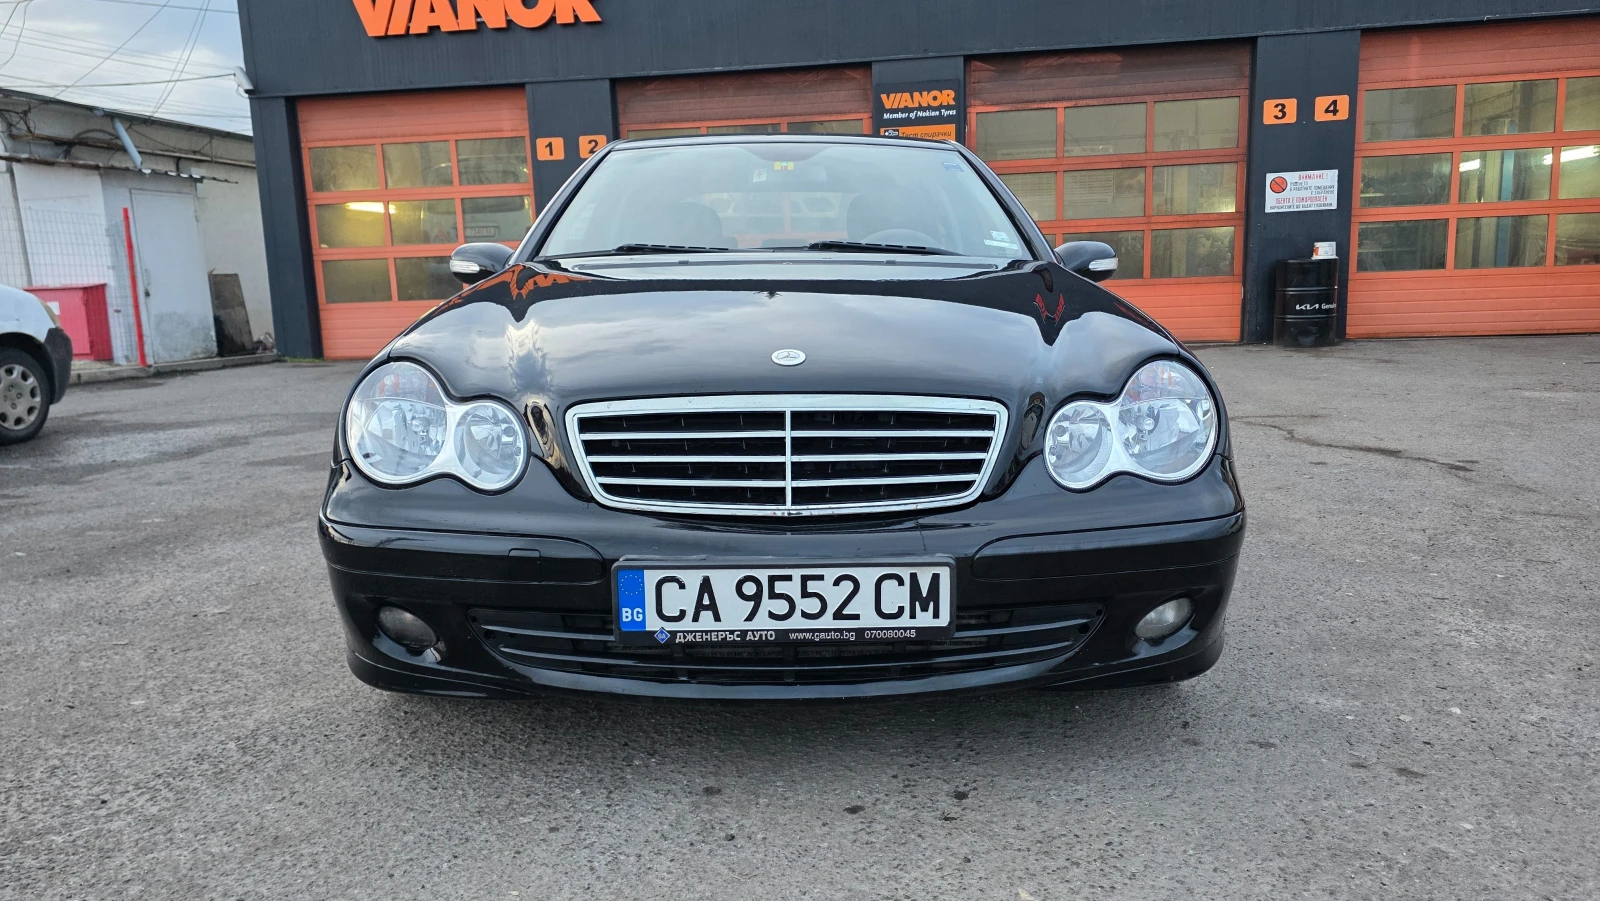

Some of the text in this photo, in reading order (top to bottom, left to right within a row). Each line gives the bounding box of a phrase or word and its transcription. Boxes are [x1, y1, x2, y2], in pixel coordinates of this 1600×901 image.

[880, 90, 956, 109] VIANOR
[1324, 99, 1339, 116] 4
[909, 111, 917, 119] of
[941, 109, 957, 117] Tyres
[1273, 103, 1287, 120] 3
[545, 142, 554, 157] 1
[587, 139, 599, 155] 2
[655, 572, 940, 622] CA 9552 CM
[621, 608, 643, 622] BG
[675, 630, 916, 643] ДЖЕНЕРЪС АУТО www.gauto.bg 070080045
